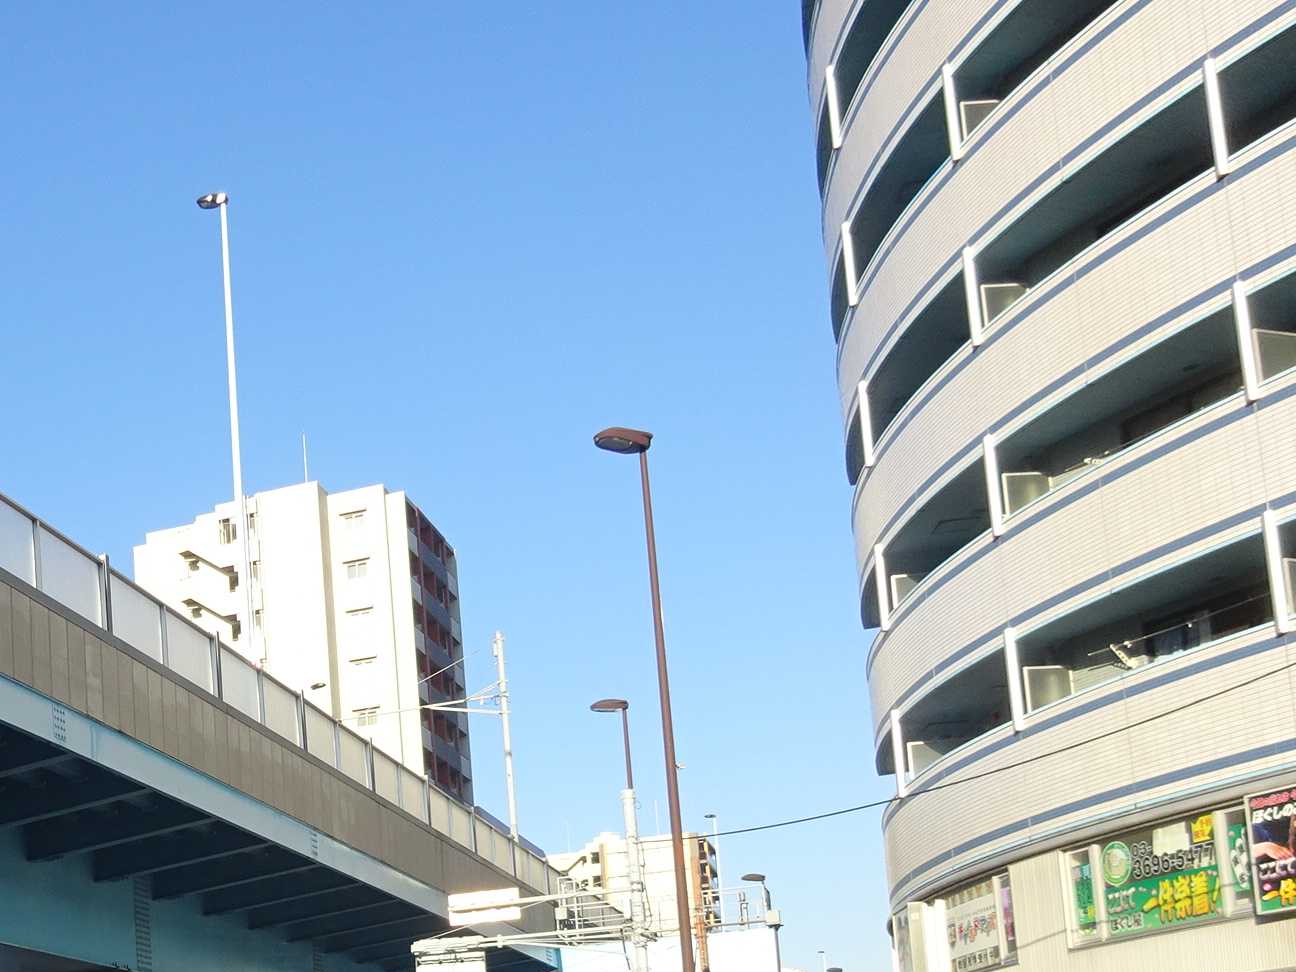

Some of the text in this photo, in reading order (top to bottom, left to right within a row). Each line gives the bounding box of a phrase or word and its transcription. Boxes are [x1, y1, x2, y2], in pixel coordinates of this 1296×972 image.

[1252, 802, 1296, 824] ほぐしの
[1133, 842, 1217, 879] 3696-5477
